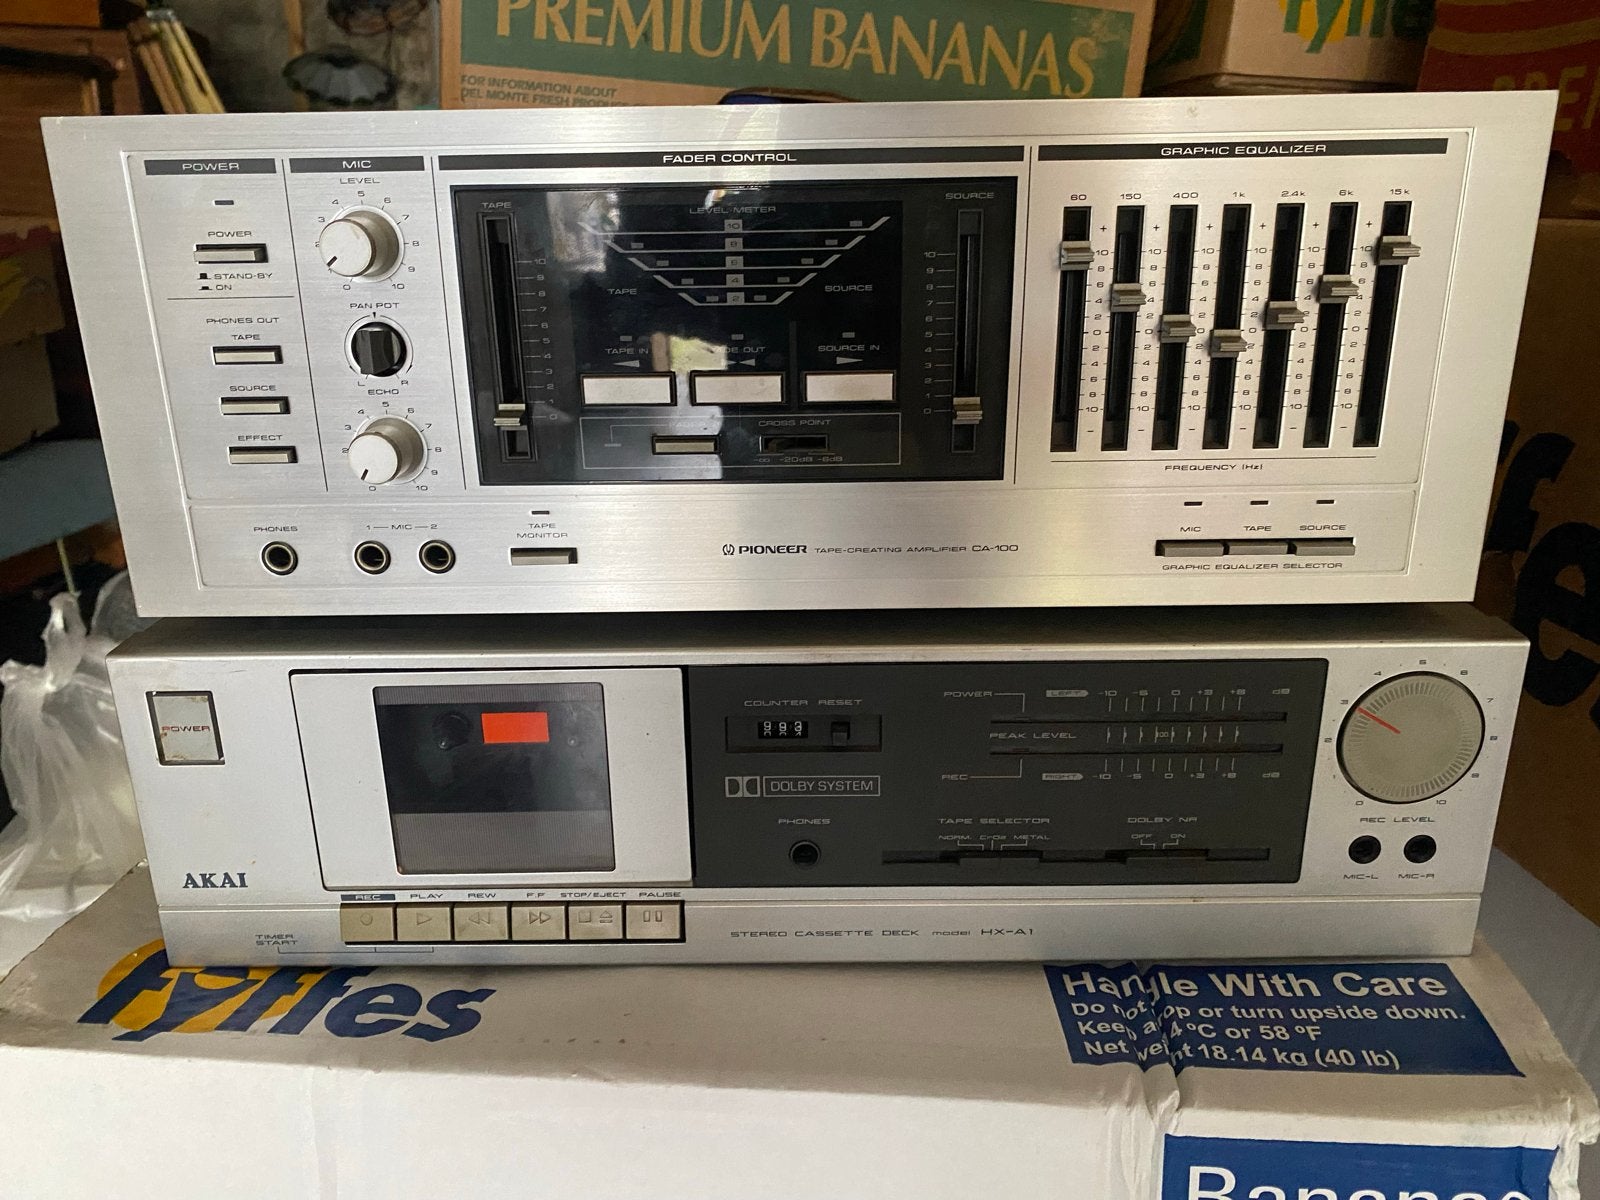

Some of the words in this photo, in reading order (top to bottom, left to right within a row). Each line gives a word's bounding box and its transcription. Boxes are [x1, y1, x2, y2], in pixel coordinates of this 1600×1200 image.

[497, 0, 790, 64] PREMIUM
[810, 7, 1098, 98] BANANAS
[461, 75, 485, 87] FOR
[487, 78, 571, 94] INFORMATION
[575, 85, 617, 98] ABOUT
[461, 88, 482, 99] DEL
[486, 90, 529, 104] MONTE
[533, 94, 570, 107] FRESH
[663, 155, 715, 163] FADER
[721, 154, 796, 162] CONTROL
[1161, 147, 1230, 157] GRAPHIC
[1235, 145, 1326, 154] EQUALIZER
[183, 163, 239, 171] POWER
[343, 160, 371, 168] MIC
[739, 545, 807, 554] PIONEER
[771, 781, 814, 791] DOLBY
[818, 781, 873, 791] SYSTEM
[183, 872, 248, 888] AKAI
[1208, 972, 1321, 997] With
[1332, 972, 1448, 997] Care
[1071, 1002, 1105, 1016] Do
[1113, 1000, 1148, 1020] not
[1198, 1007, 1223, 1018] or
[1230, 1005, 1284, 1019] turn
[1292, 1005, 1378, 1022] upside
[1386, 1005, 1466, 1020] down.
[1077, 1021, 1138, 1041] Keep
[1225, 1027, 1251, 1039] or
[1260, 1025, 1290, 1041] 58
[1084, 1039, 1130, 1056] Net
[1198, 1045, 1267, 1063] 18.14
[1273, 1048, 1308, 1067] kg
[1315, 1048, 1356, 1067] (40
[1361, 1050, 1401, 1071] lb)
